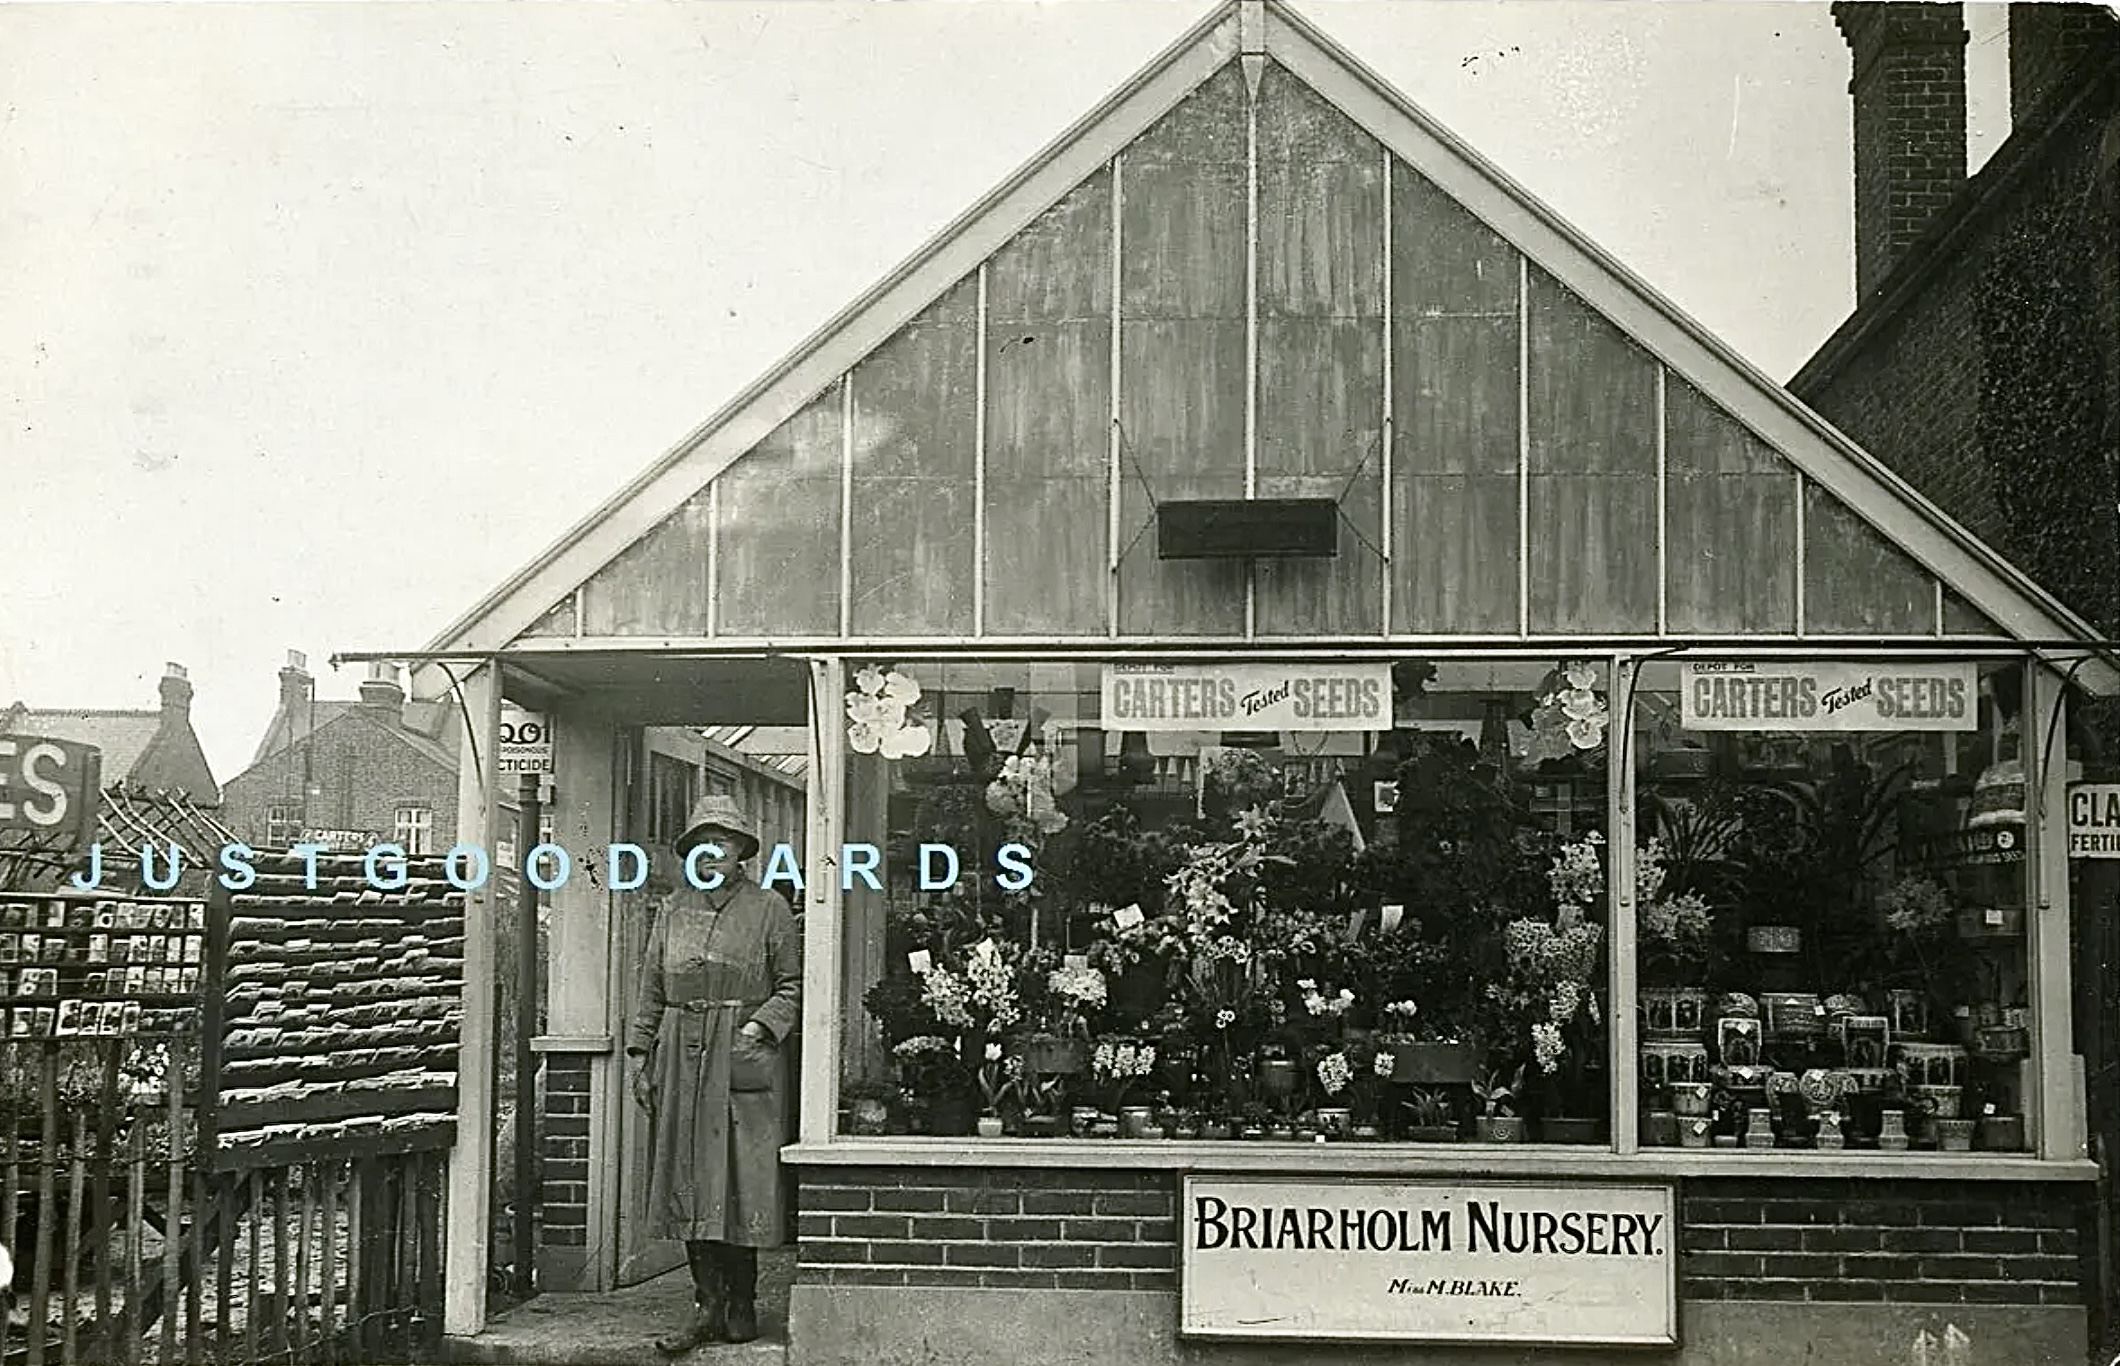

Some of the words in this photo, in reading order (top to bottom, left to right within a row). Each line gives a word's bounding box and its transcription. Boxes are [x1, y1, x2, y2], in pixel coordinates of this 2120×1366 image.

[1113, 678, 1237, 719] CARTERS
[1240, 680, 1291, 717] Tested
[1293, 678, 1381, 719] SEEDS
[1693, 677, 1818, 719] CARTERS
[1820, 677, 1873, 715] Tested
[1876, 677, 1967, 719] SEEDS
[1194, 1196, 1452, 1251] BRIARHOLM
[1467, 1201, 1665, 1256] NURSERY.
